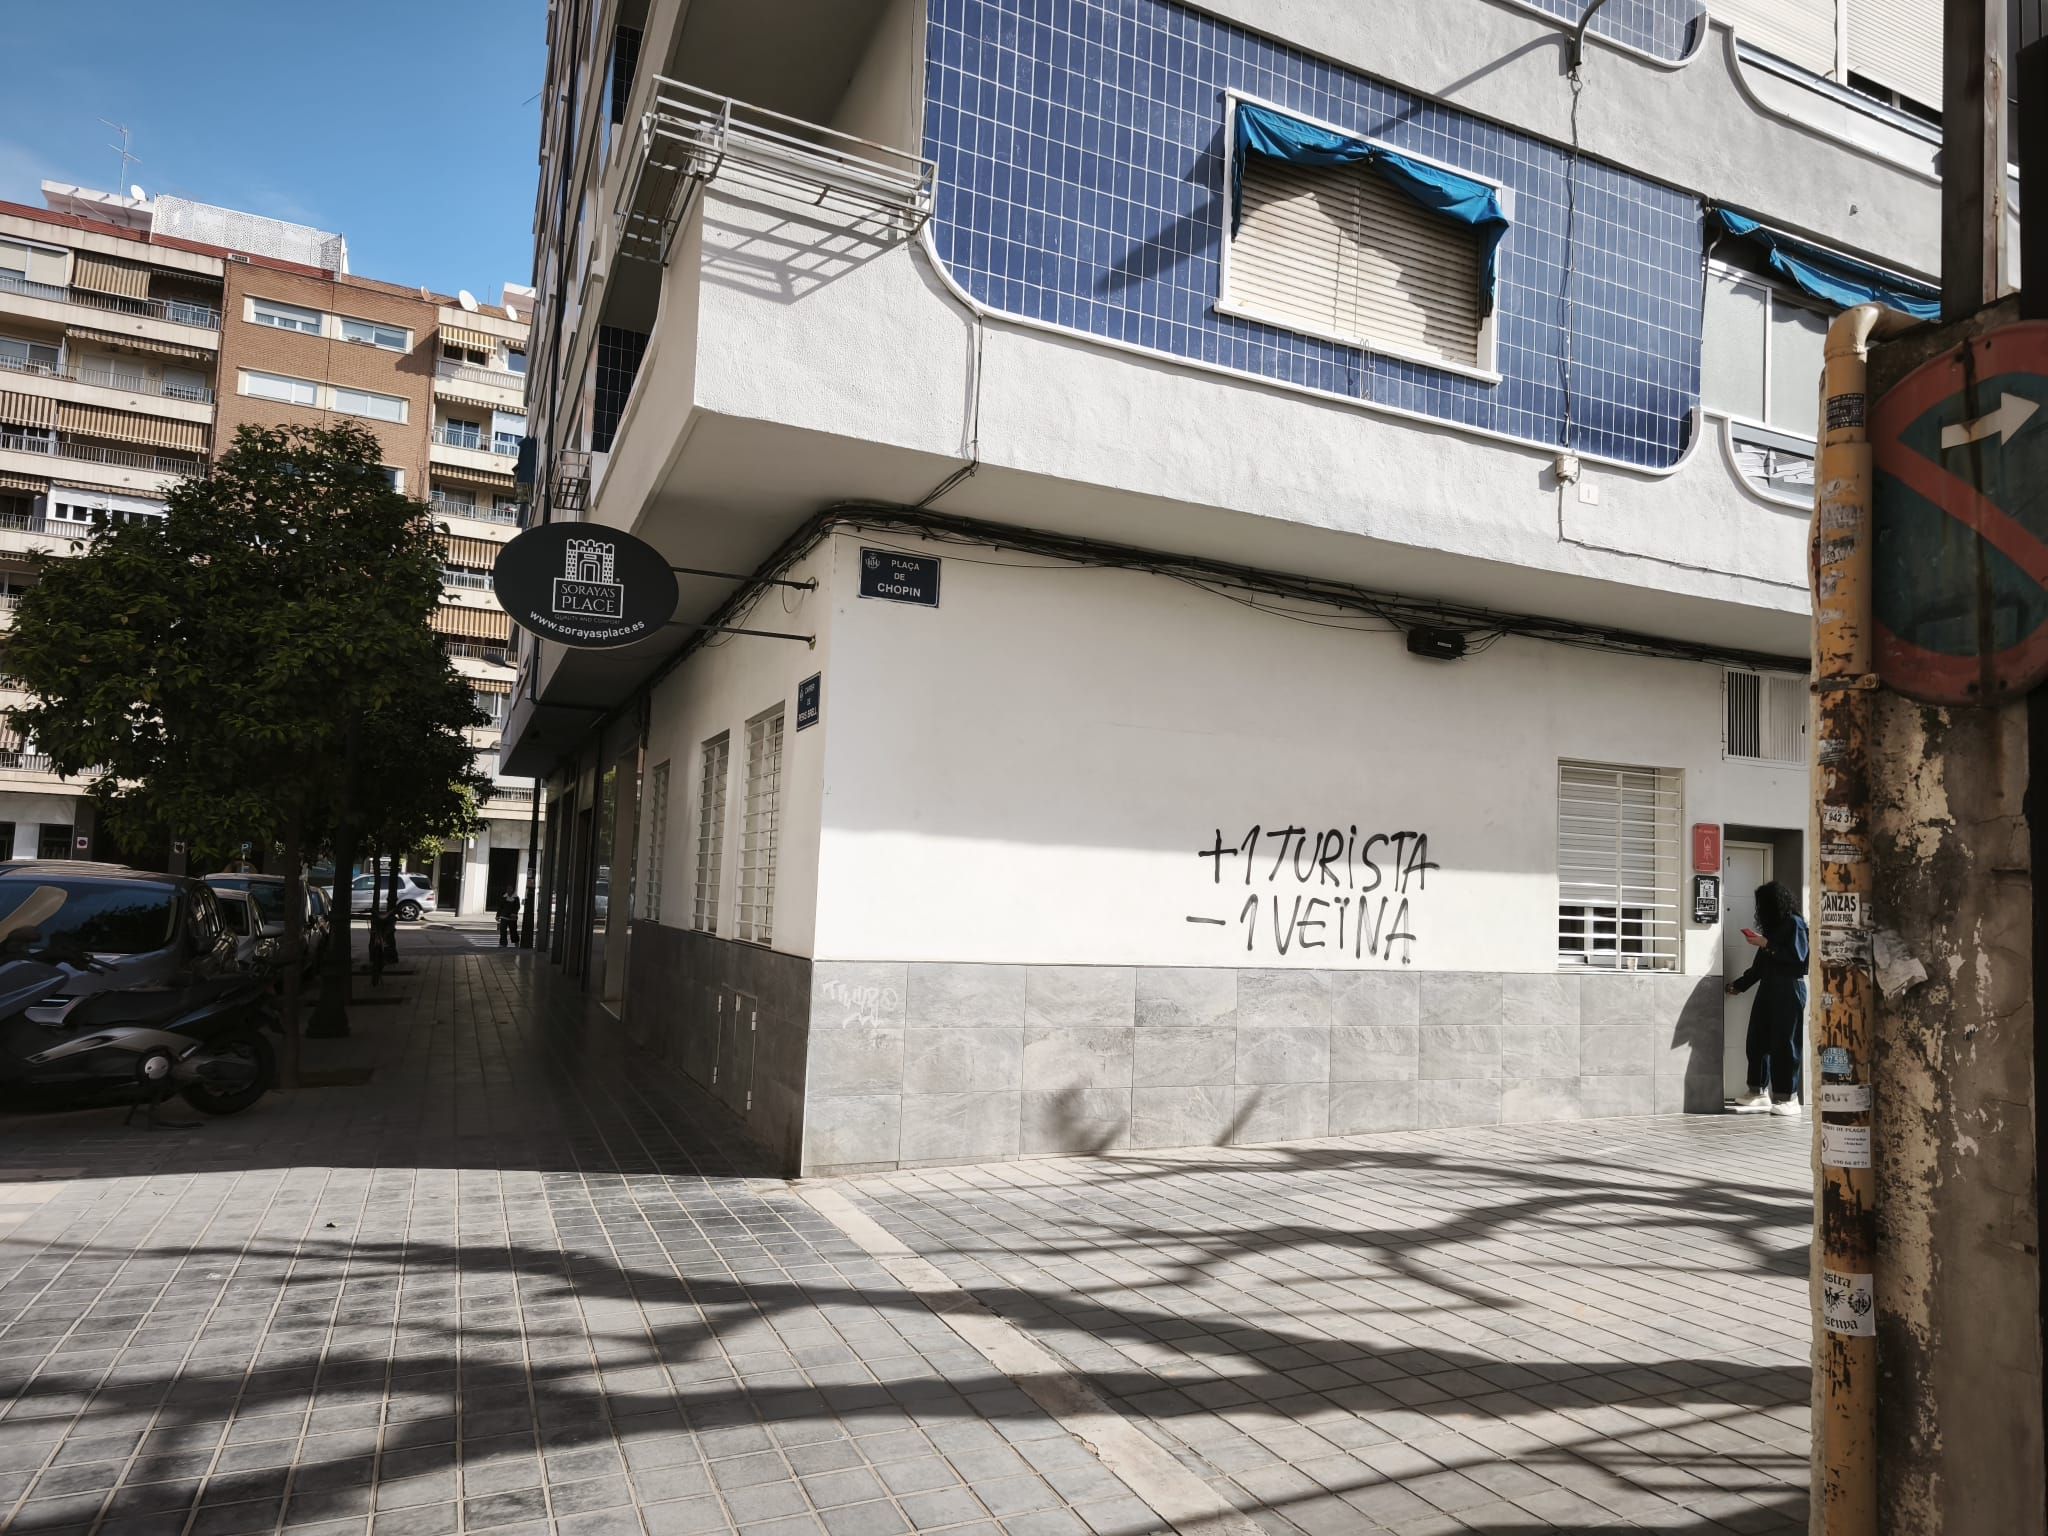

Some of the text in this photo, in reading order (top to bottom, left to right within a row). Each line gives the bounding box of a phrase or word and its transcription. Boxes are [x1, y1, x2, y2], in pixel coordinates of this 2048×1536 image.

[891, 559, 920, 572] PLAÇA
[893, 572, 905, 581] DE
[560, 583, 616, 599] SORAYA'S
[877, 582, 921, 598] CHOPIN
[561, 595, 615, 613] PLACE
[529, 610, 646, 640] www.sorayasplace.es
